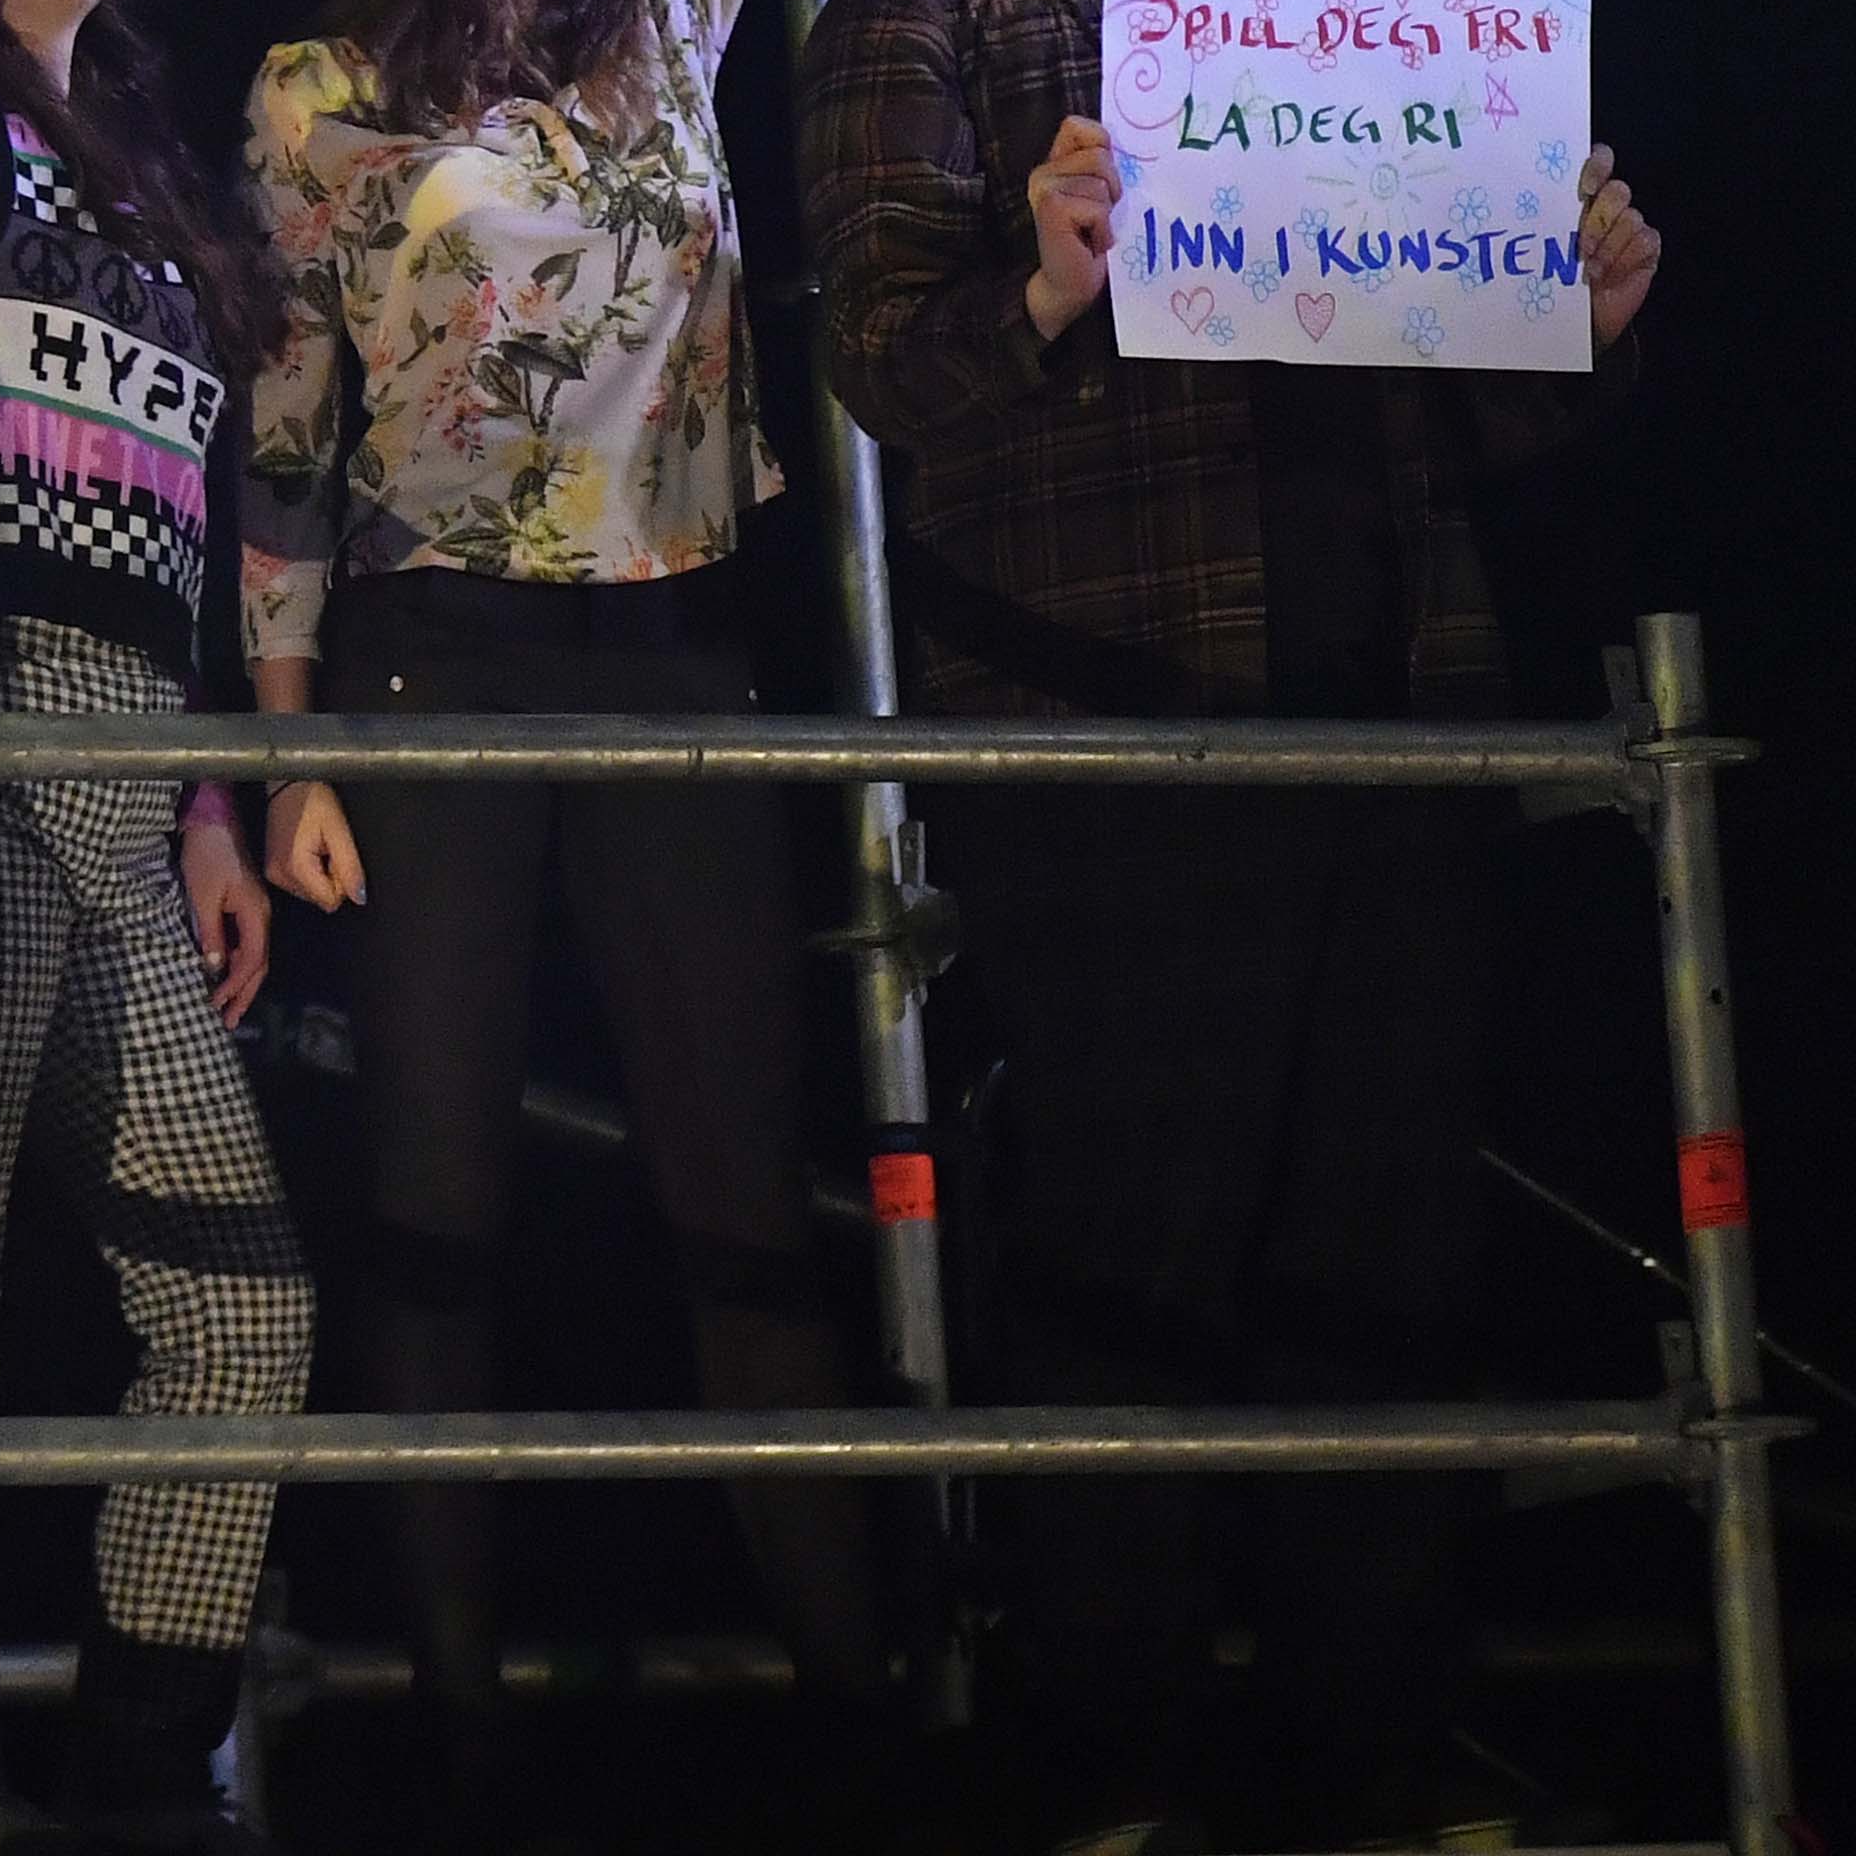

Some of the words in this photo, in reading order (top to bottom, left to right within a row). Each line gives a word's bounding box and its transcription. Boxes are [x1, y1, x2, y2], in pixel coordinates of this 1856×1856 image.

[1315, 5, 1442, 55] DEG
[1464, 4, 1552, 53] FRI
[1177, 93, 1251, 154] LA
[1272, 103, 1381, 149] DEG
[1402, 101, 1462, 149] RI
[1143, 206, 1244, 276] INN
[1274, 226, 1289, 278] I
[1319, 227, 1579, 286] KUNSTEN
[29, 311, 218, 446] HYPE
